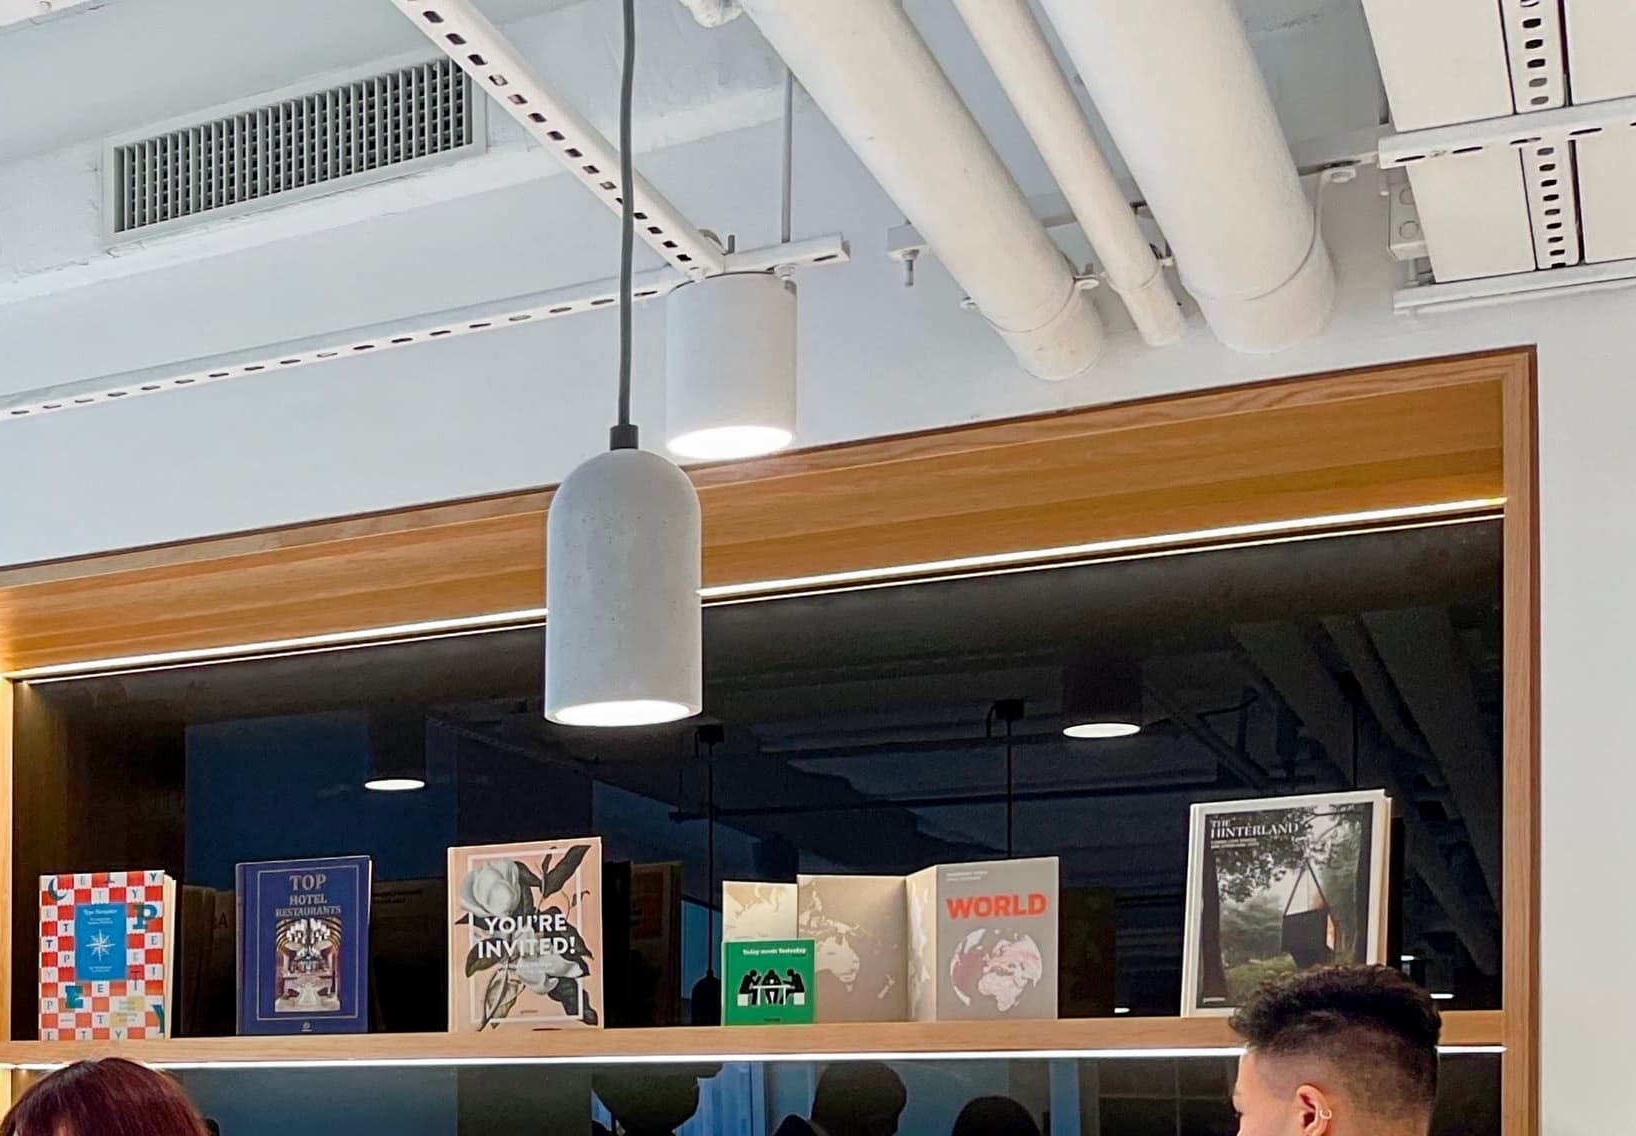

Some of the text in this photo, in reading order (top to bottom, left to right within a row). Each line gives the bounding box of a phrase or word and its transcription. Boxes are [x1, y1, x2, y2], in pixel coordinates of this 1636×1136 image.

[1210, 823, 1299, 839] HINTERLAND
[289, 873, 327, 892] TOP
[289, 894, 328, 906] HOTEL
[946, 893, 1049, 920] WORLD
[275, 905, 341, 918] RESTAURANTS
[477, 936, 575, 959] INVITED!
